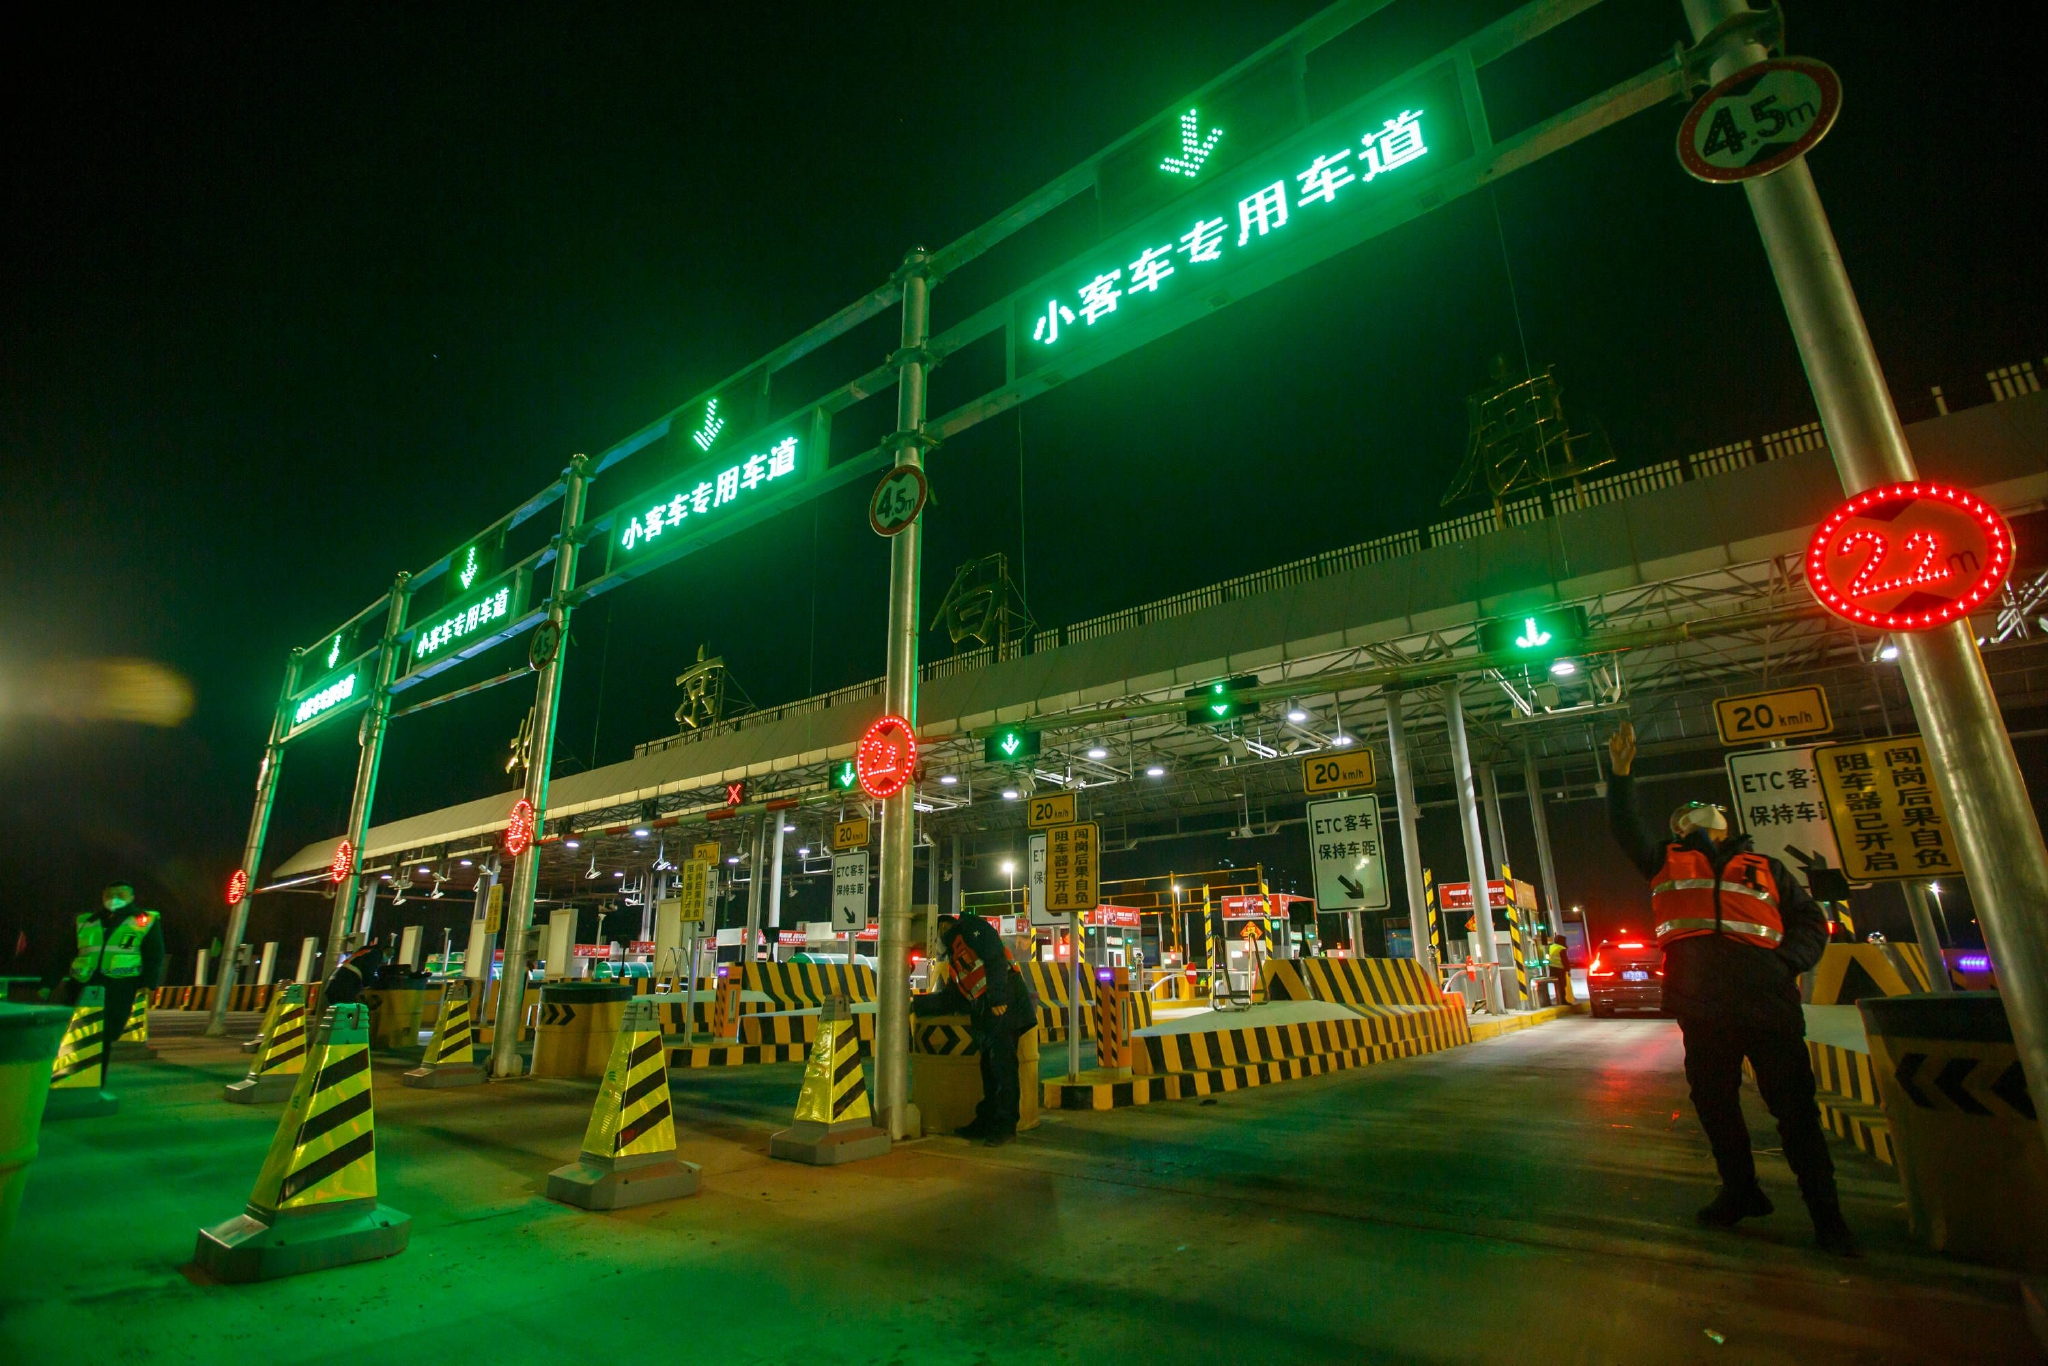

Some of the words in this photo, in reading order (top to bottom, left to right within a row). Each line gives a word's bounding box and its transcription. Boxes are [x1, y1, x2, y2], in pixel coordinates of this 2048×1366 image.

[1702, 94, 1817, 158] 4.5m
[1034, 111, 1427, 344] 小客车专用车道
[622, 437, 797, 549] 小客车专用车道
[877, 486, 915, 518] 4.5m
[417, 588, 508, 657] 小客车专用车道
[1733, 704, 1775, 732] 20
[1779, 711, 1813, 727] km/h
[1314, 762, 1340, 785] 20
[1342, 768, 1364, 781] km/h
[1741, 768, 1817, 793] ETC客
[1035, 803, 1053, 821] 20
[1054, 809, 1070, 819] km/h
[1833, 752, 1899, 872] 阻车器已开启
[1884, 746, 1952, 869] 闯岗后果自负
[839, 827, 852, 842] 20
[1318, 840, 1377, 861] 保持车距
[836, 883, 865, 897] 保持车距
[1054, 830, 1070, 905] 阻车器已开启
[1074, 828, 1090, 904] 闯岗后果自负
